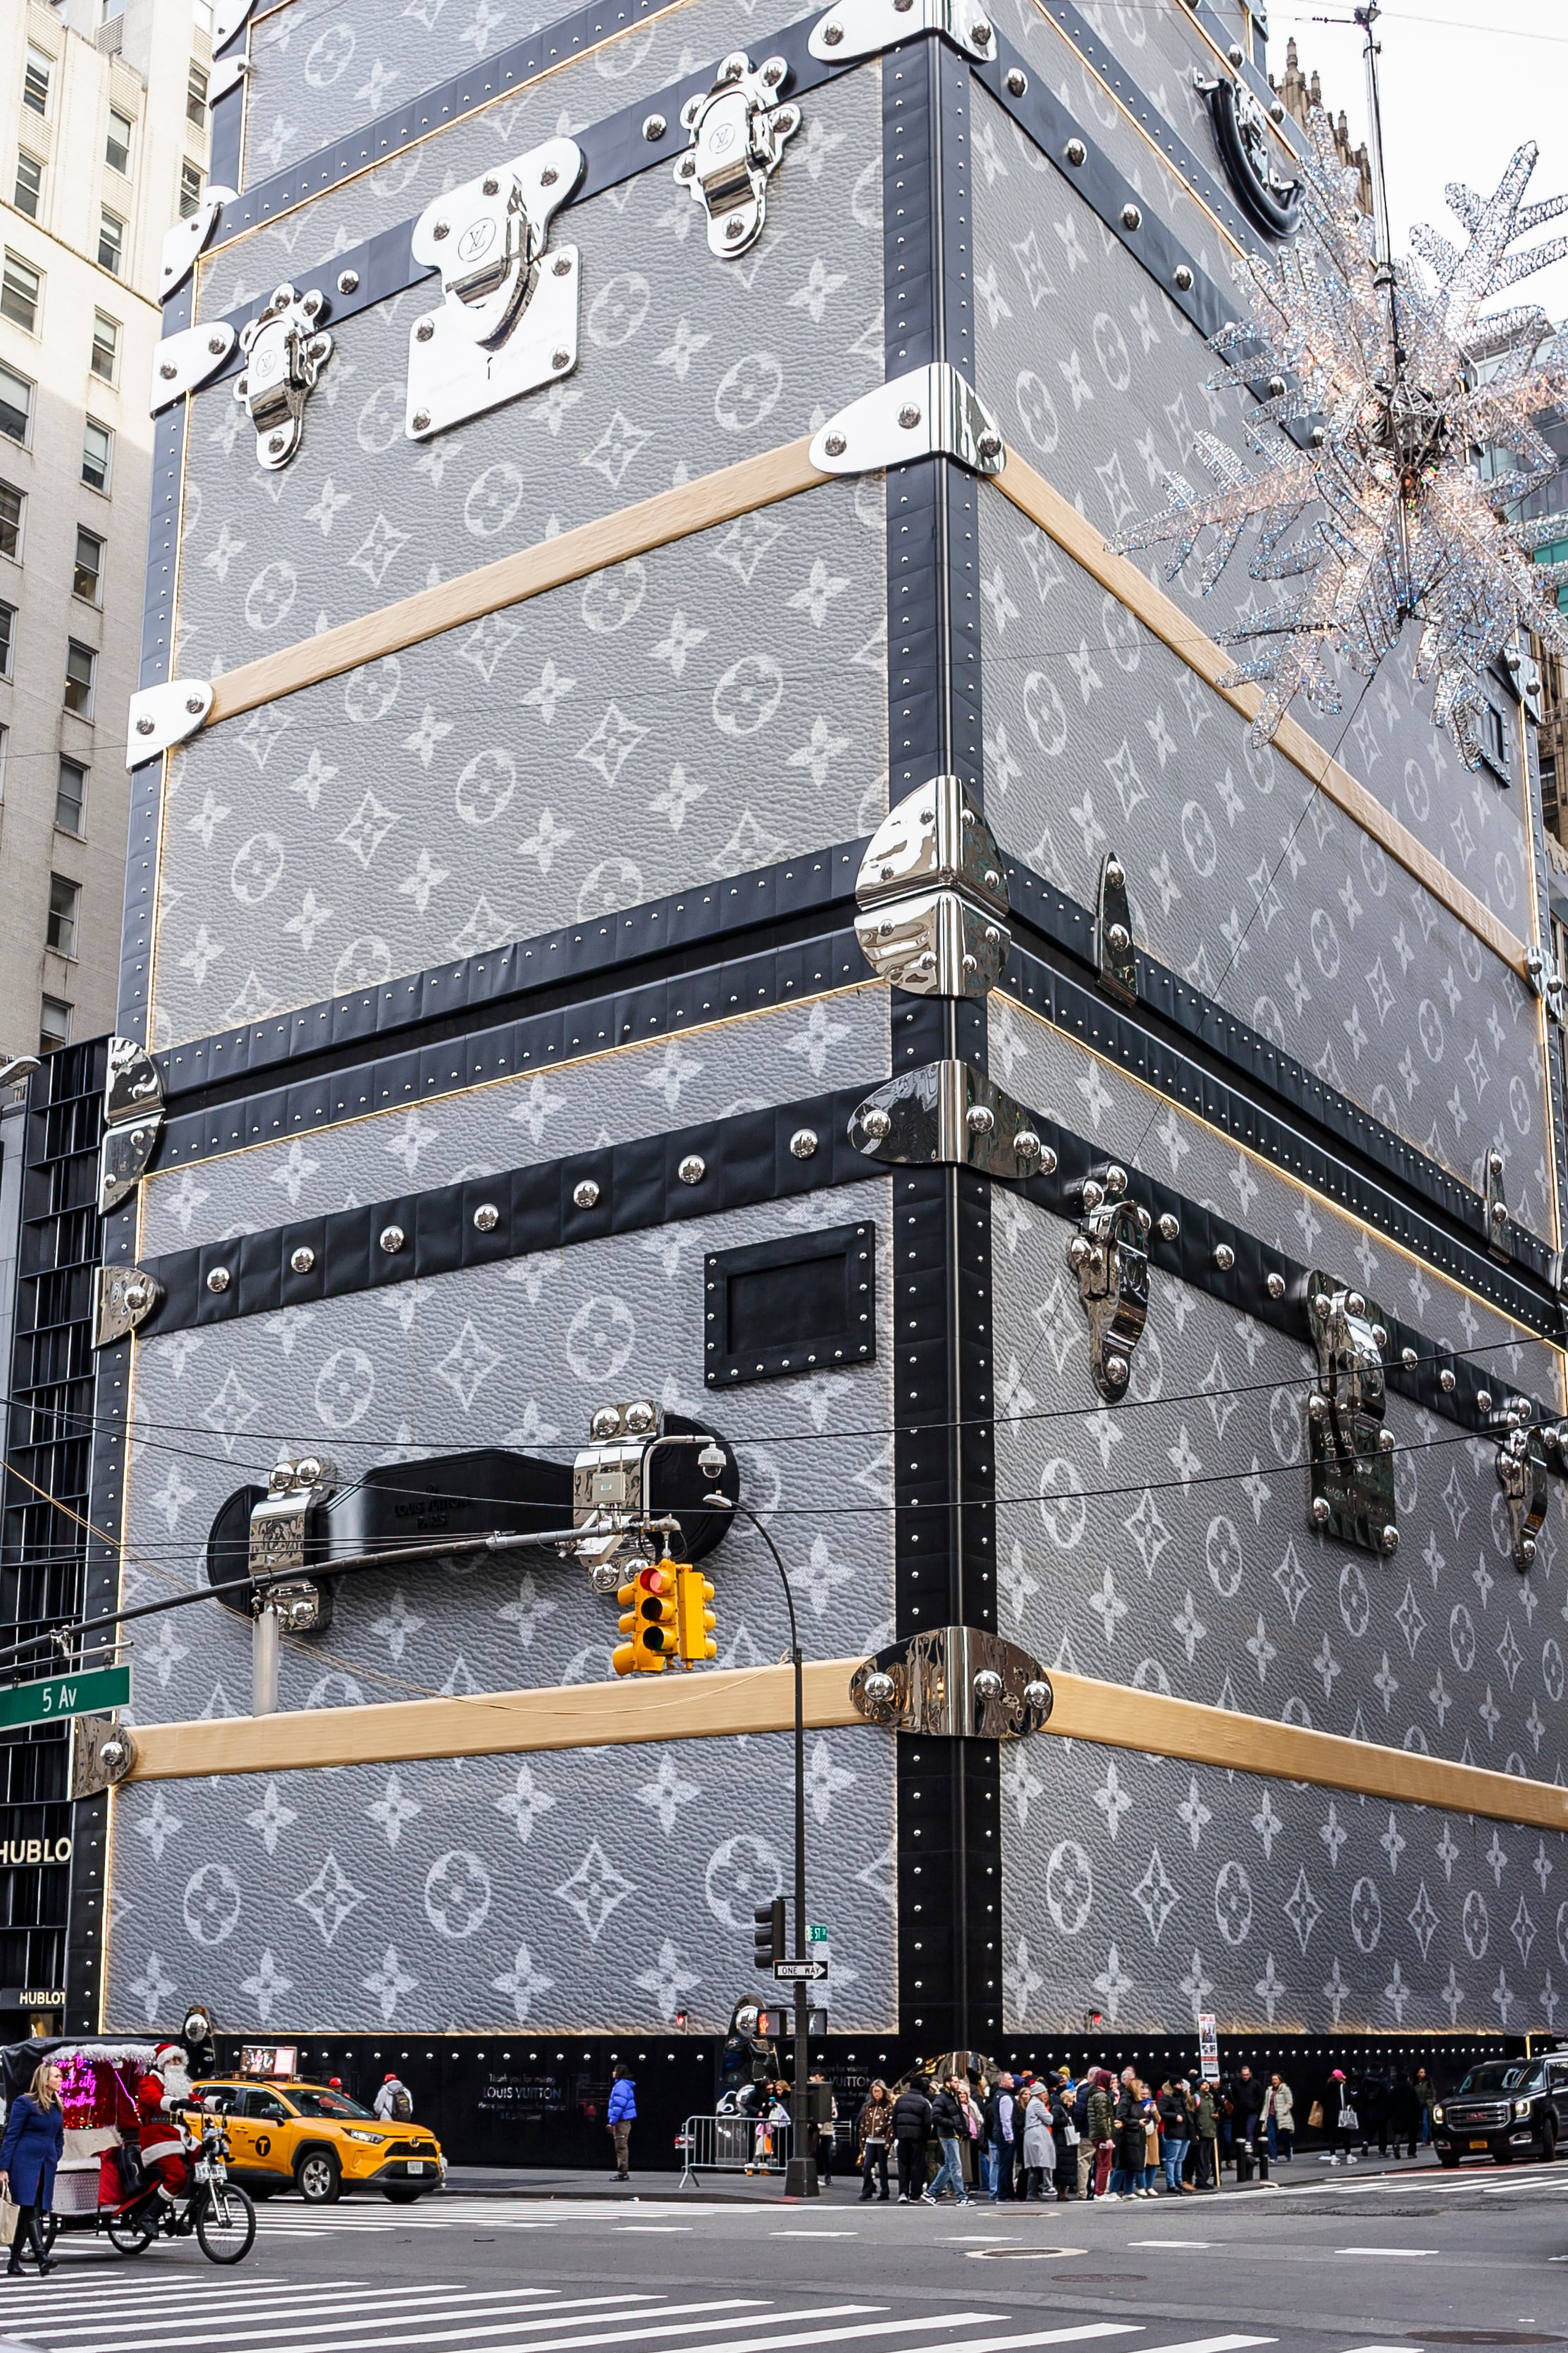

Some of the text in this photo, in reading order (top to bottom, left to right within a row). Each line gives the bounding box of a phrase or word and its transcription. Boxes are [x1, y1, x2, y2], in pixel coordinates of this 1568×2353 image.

[43, 1685, 78, 1712] 5 Av
[814, 1927, 821, 1940] 57
[19, 1991, 66, 2005] HUBLOT
[483, 2087, 562, 2099] LOUIS VUITTON
